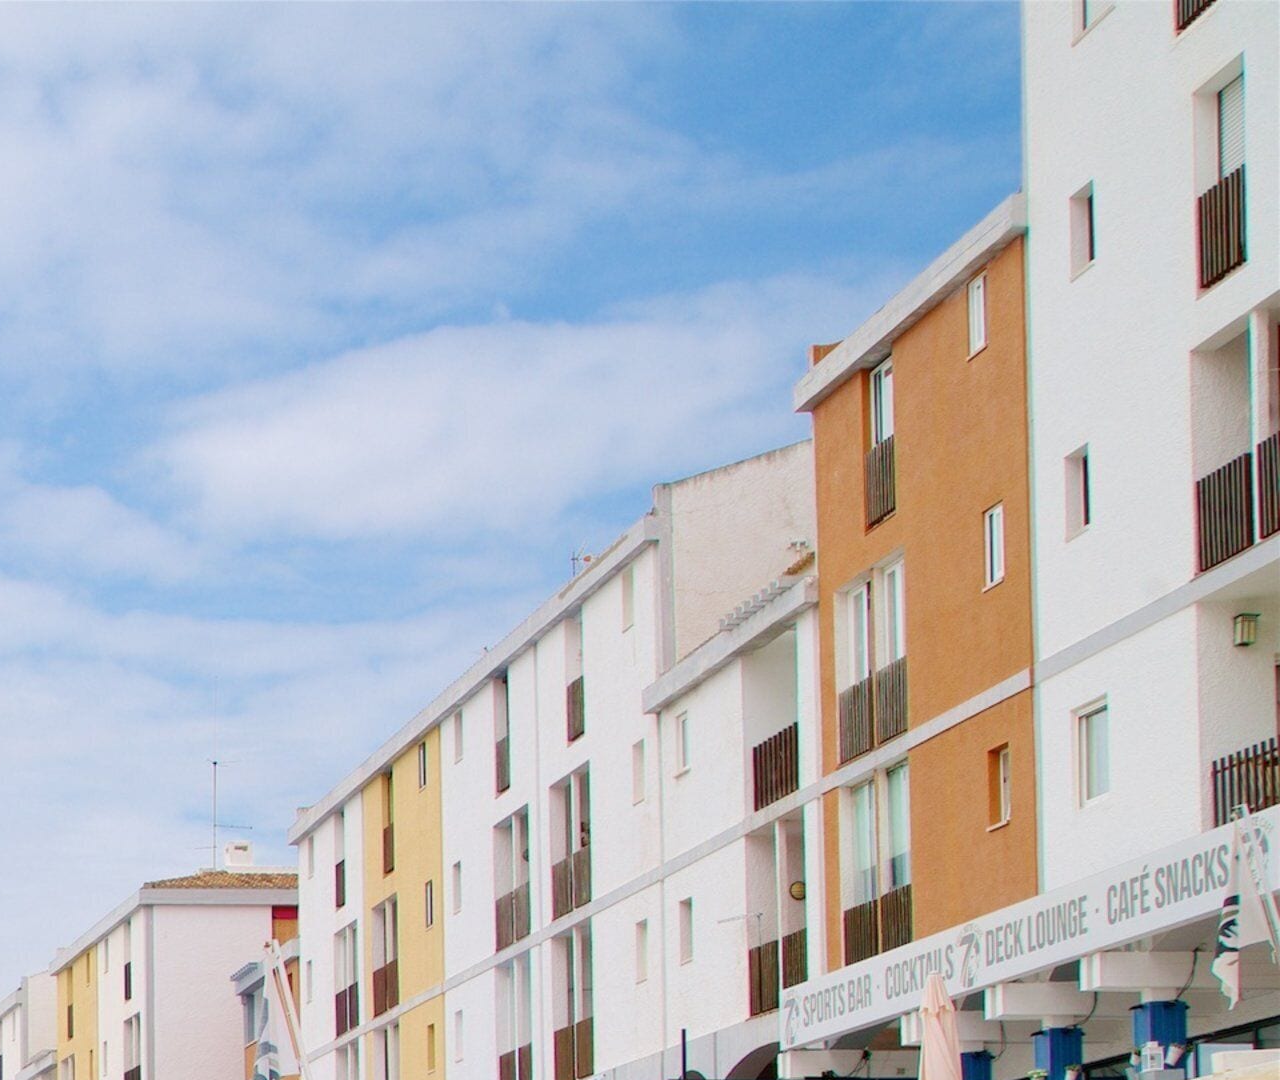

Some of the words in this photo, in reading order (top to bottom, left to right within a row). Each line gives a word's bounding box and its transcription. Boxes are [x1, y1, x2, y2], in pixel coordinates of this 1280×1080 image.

[802, 983, 846, 1028] SPORTS
[847, 973, 872, 1013] BAR
[884, 943, 954, 1001] COCKTAILS
[985, 917, 1024, 967] DECK
[1027, 894, 1089, 953] LOUNGE
[1106, 864, 1151, 926] CAFÉ
[1154, 843, 1230, 909] SNACKS
